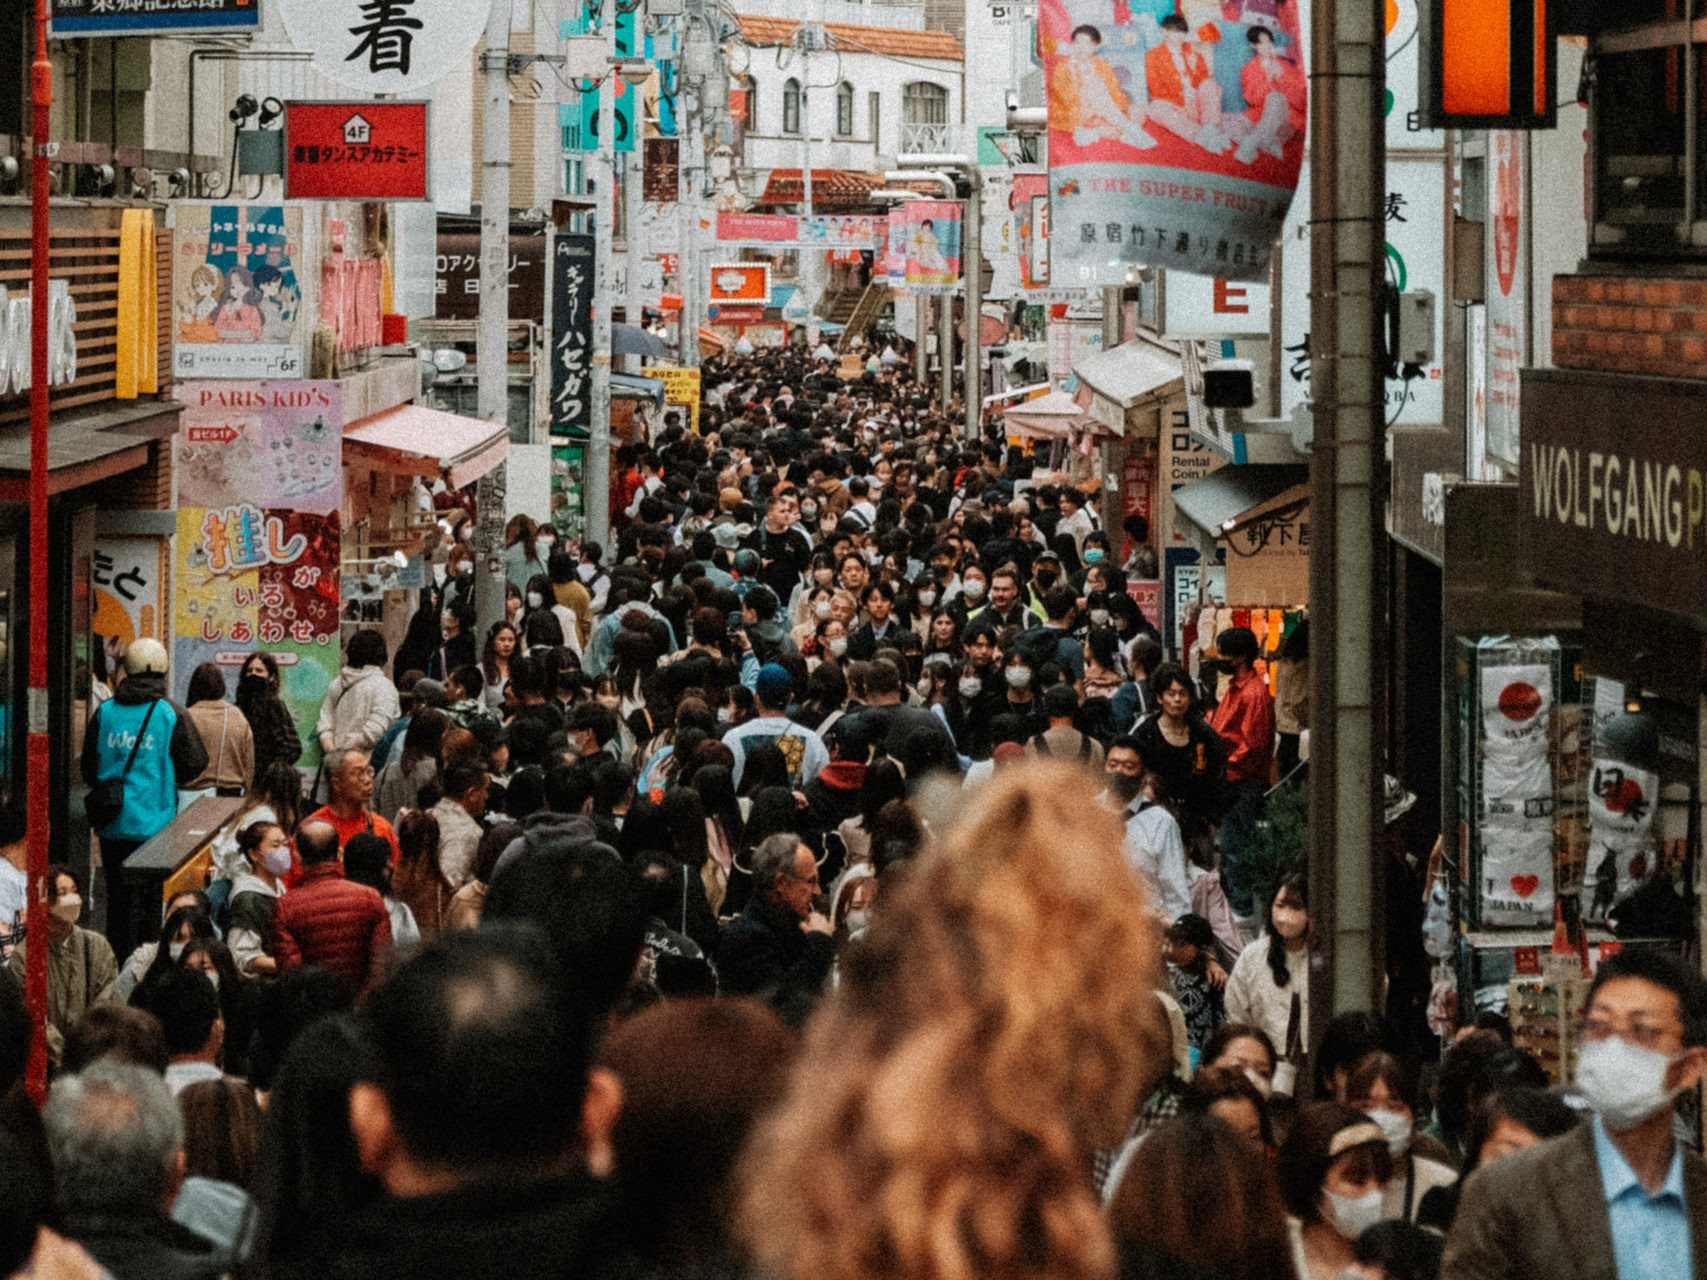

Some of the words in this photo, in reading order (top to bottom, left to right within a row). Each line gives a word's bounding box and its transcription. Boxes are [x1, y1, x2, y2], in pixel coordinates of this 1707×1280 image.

[347, 126, 367, 139] 4F
[1087, 178, 1131, 193] THE
[1140, 180, 1206, 203] SUPER
[280, 360, 298, 372] 6F
[555, 330, 589, 422] ハセガワ
[200, 391, 266, 407] PARIS
[273, 388, 330, 407] KID'S
[1172, 456, 1210, 467] Rental
[1172, 470, 1198, 480] Coin
[1532, 442, 1682, 548] WOLFGANG
[205, 509, 304, 570] 推し
[295, 566, 319, 588] が
[235, 585, 284, 607] いる
[202, 620, 329, 645] しあわせ。
[107, 730, 154, 750] Wot
[1490, 900, 1534, 912] JAPAN
